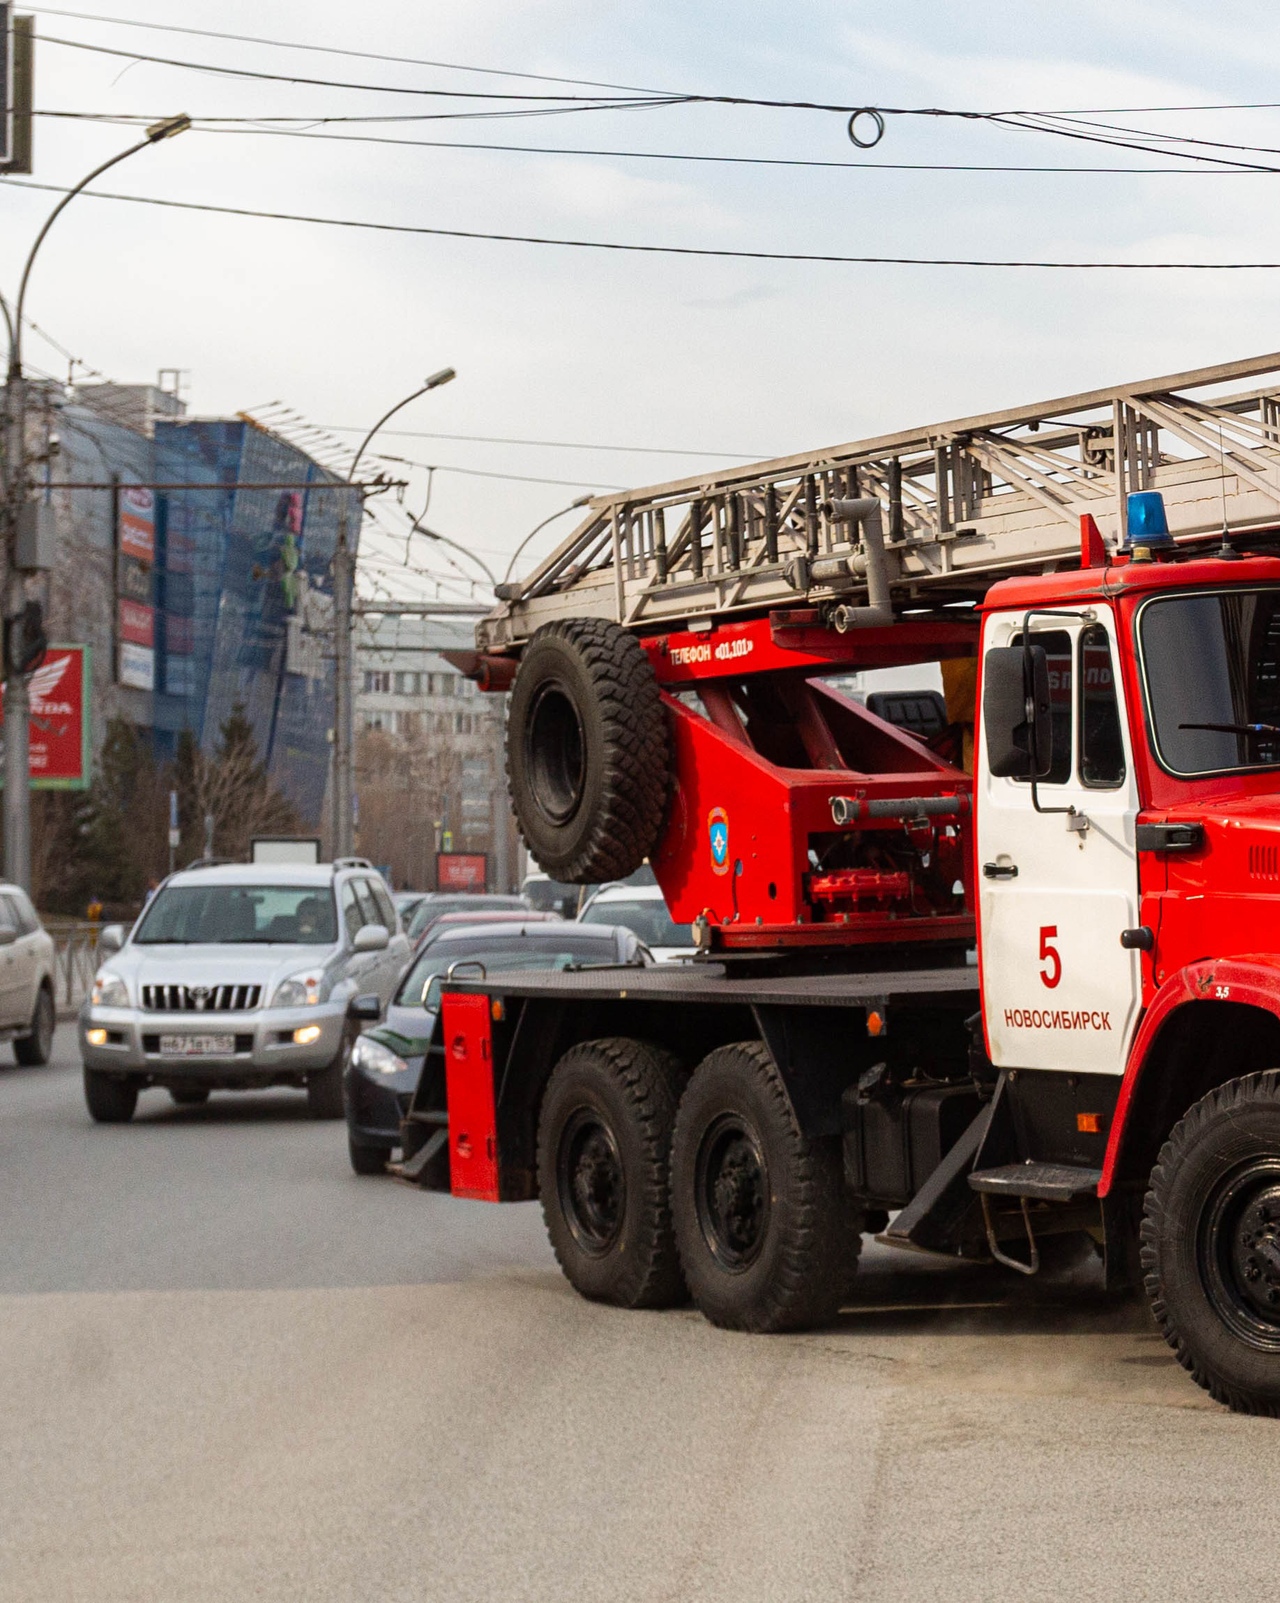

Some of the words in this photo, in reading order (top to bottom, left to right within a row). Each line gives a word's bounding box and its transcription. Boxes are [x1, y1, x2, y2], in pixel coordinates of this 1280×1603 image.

[670, 644, 711, 666] ТЕЛЕФОН
[1039, 925, 1062, 989] 5
[1215, 986, 1229, 998] 3,5
[1004, 1008, 1112, 1030] НОВОСИБИРСК
